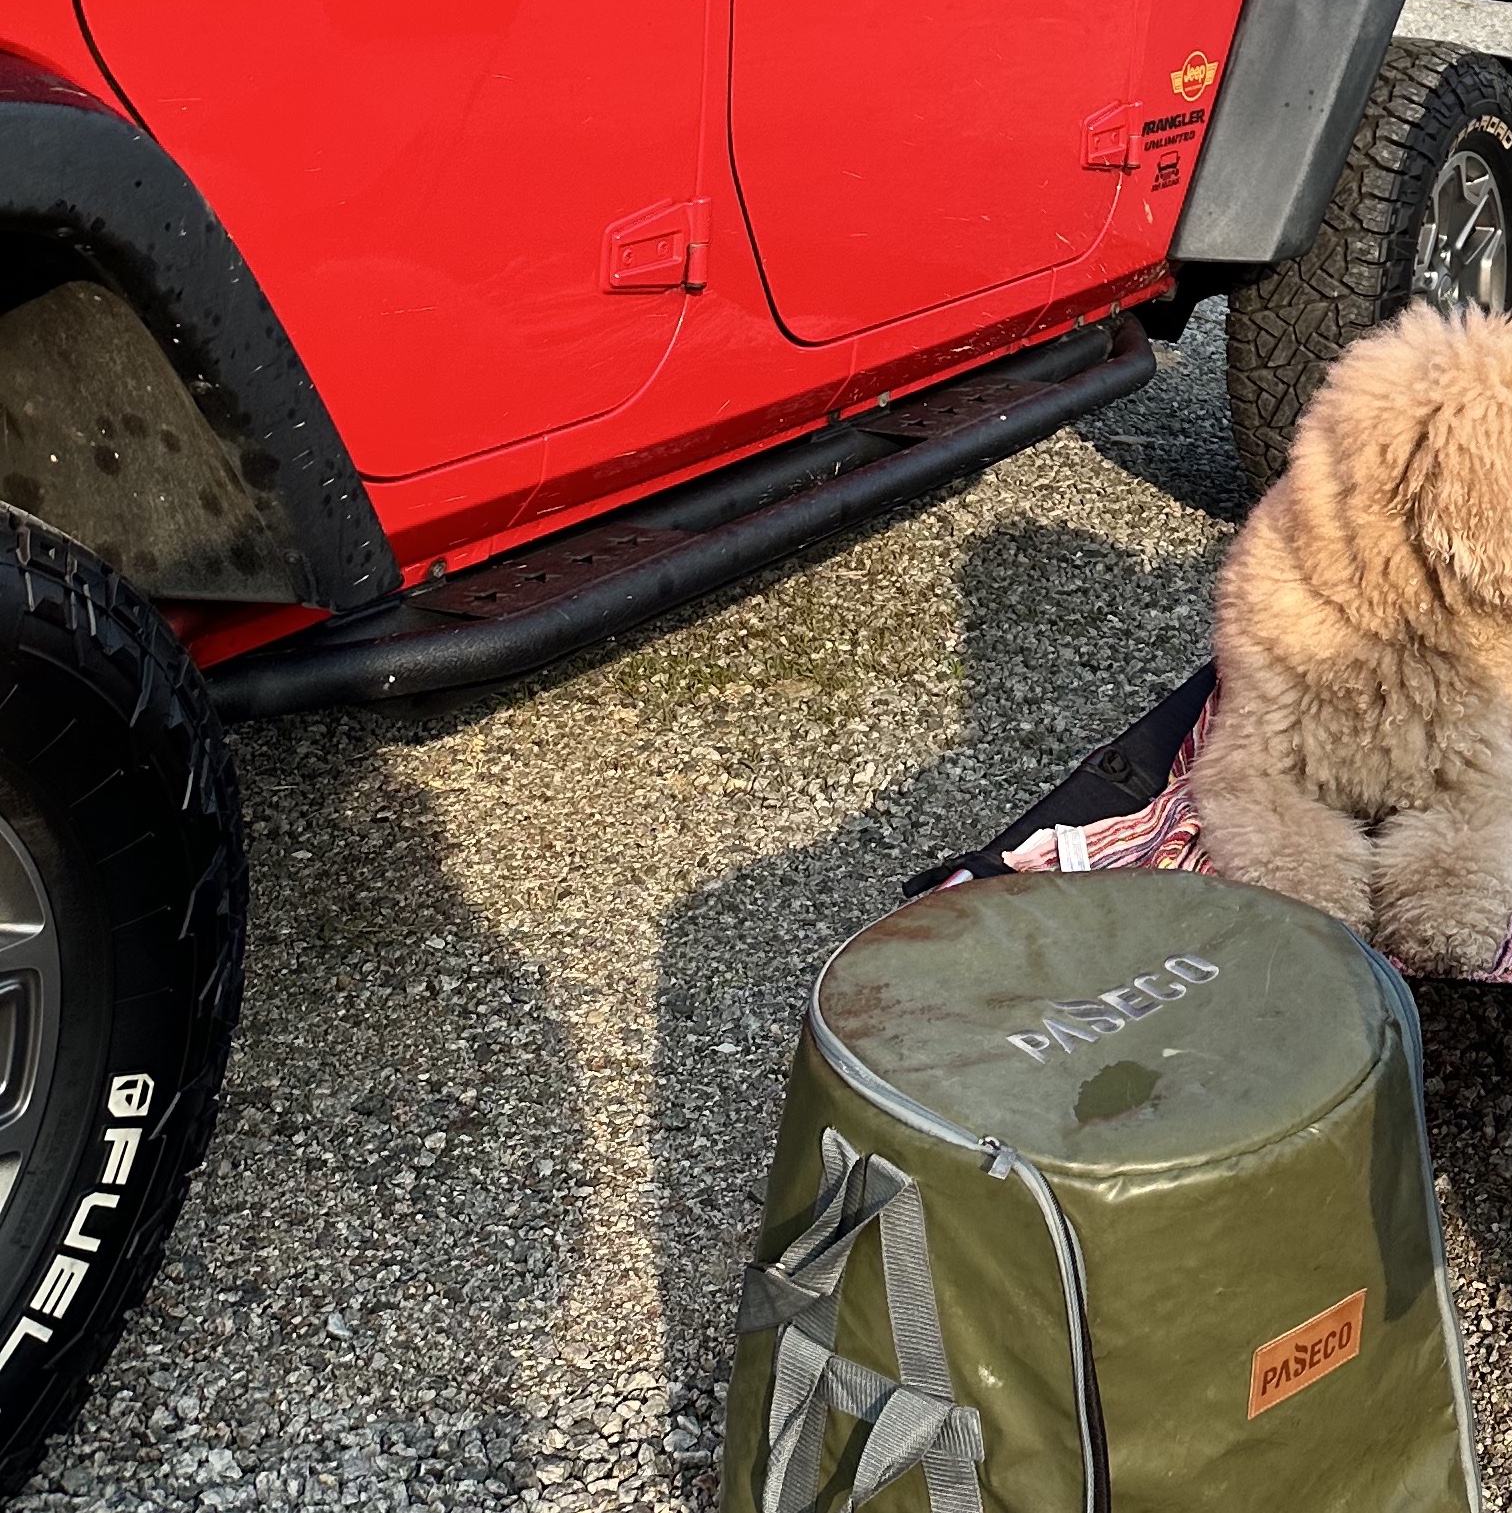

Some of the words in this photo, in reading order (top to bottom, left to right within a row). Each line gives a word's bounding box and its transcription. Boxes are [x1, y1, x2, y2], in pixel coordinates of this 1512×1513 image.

[1183, 63, 1206, 84] Jeep
[1144, 130, 1196, 152] UNLIMITED
[1006, 953, 1220, 1065] PASECO
[0, 1127, 143, 1372] FUEL
[1261, 1321, 1353, 1397] PASECO
